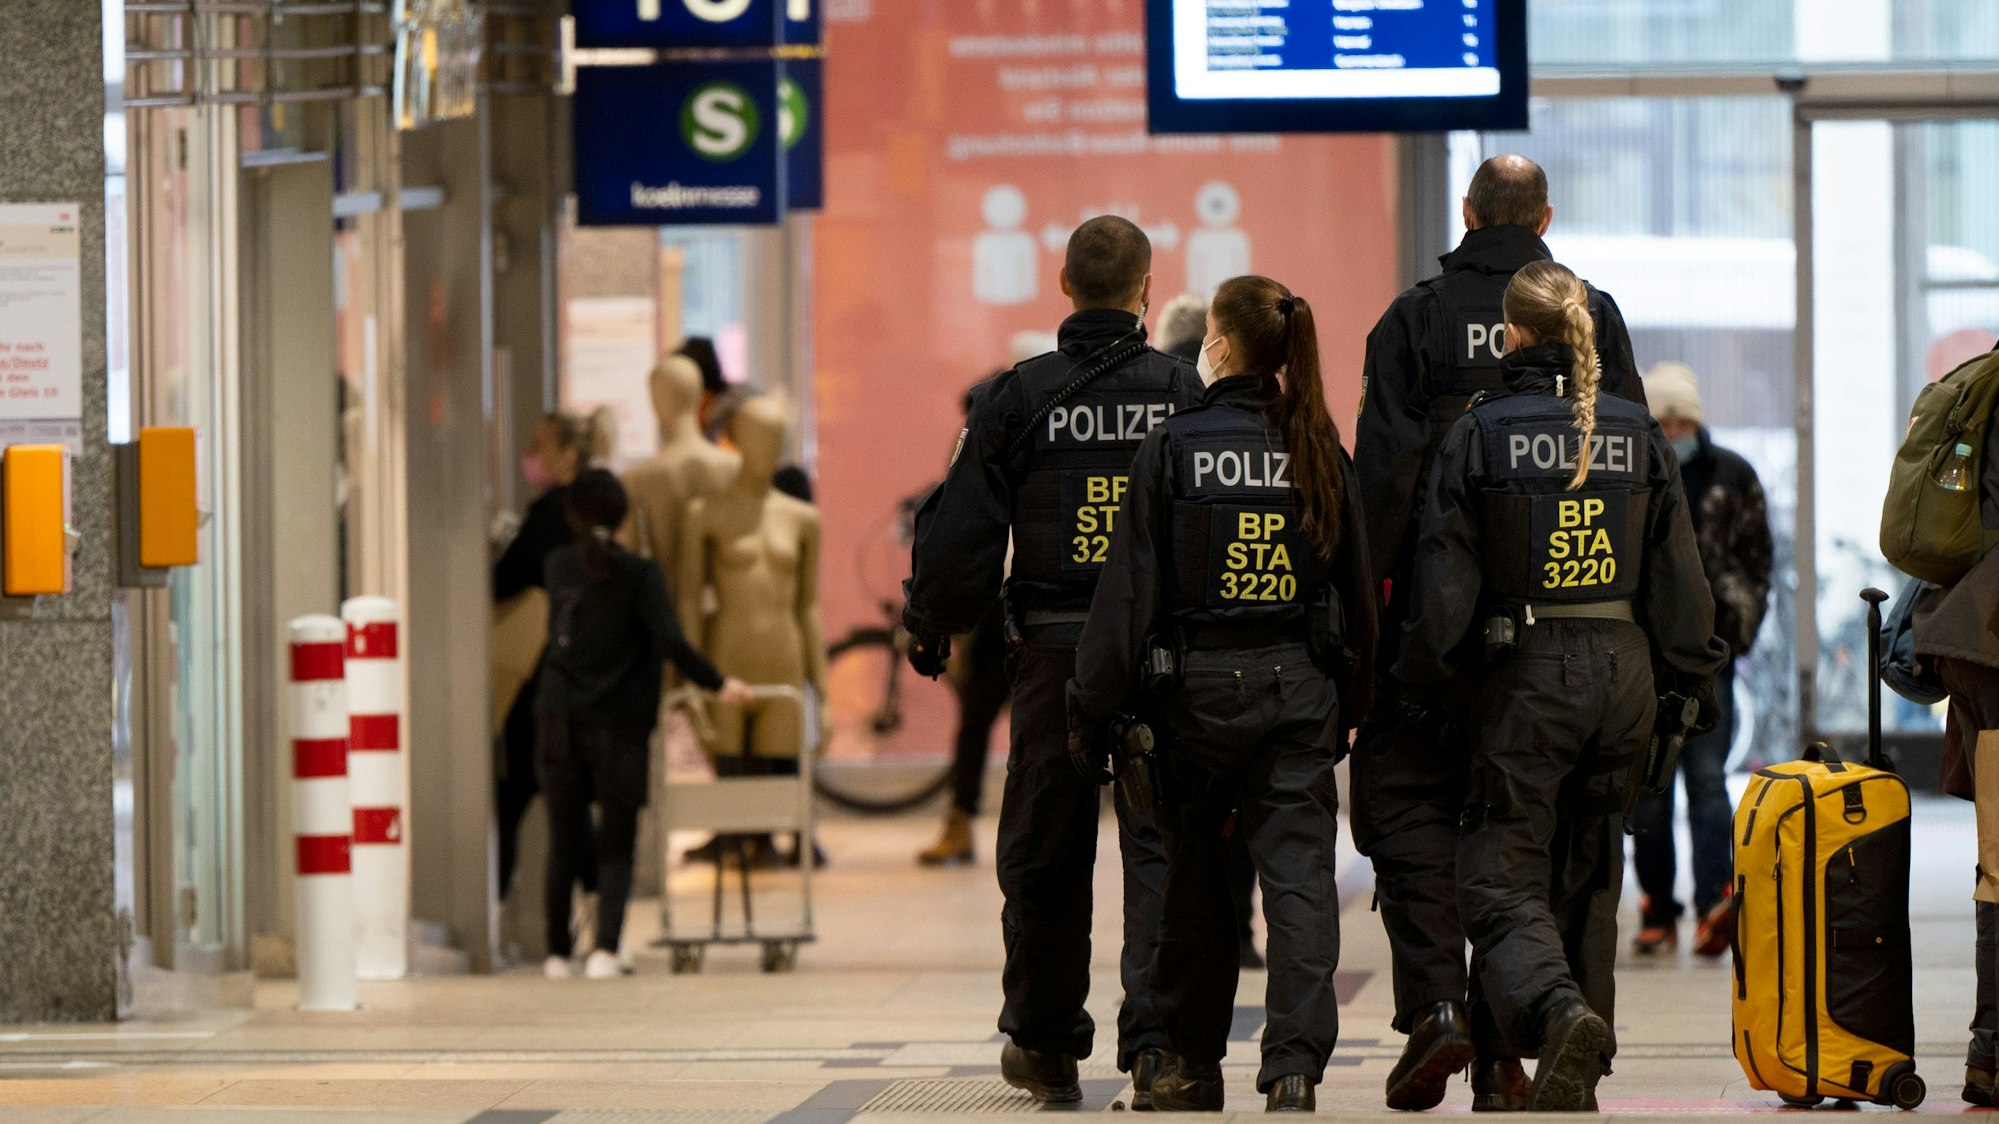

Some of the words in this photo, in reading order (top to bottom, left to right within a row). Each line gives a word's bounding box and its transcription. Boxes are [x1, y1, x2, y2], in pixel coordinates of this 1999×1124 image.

[692, 88, 748, 156] S
[1049, 403, 1175, 441] POLIZE
[1194, 450, 1300, 488] POLIZ
[1076, 506, 1120, 533] ST
[1238, 512, 1286, 540] BP
[1559, 499, 1605, 528] BP
[1072, 535, 1110, 563] 32
[1225, 542, 1293, 571] STA
[1548, 528, 1613, 559] STA
[1219, 572, 1297, 602] 3220
[1542, 557, 1617, 589] 3220
